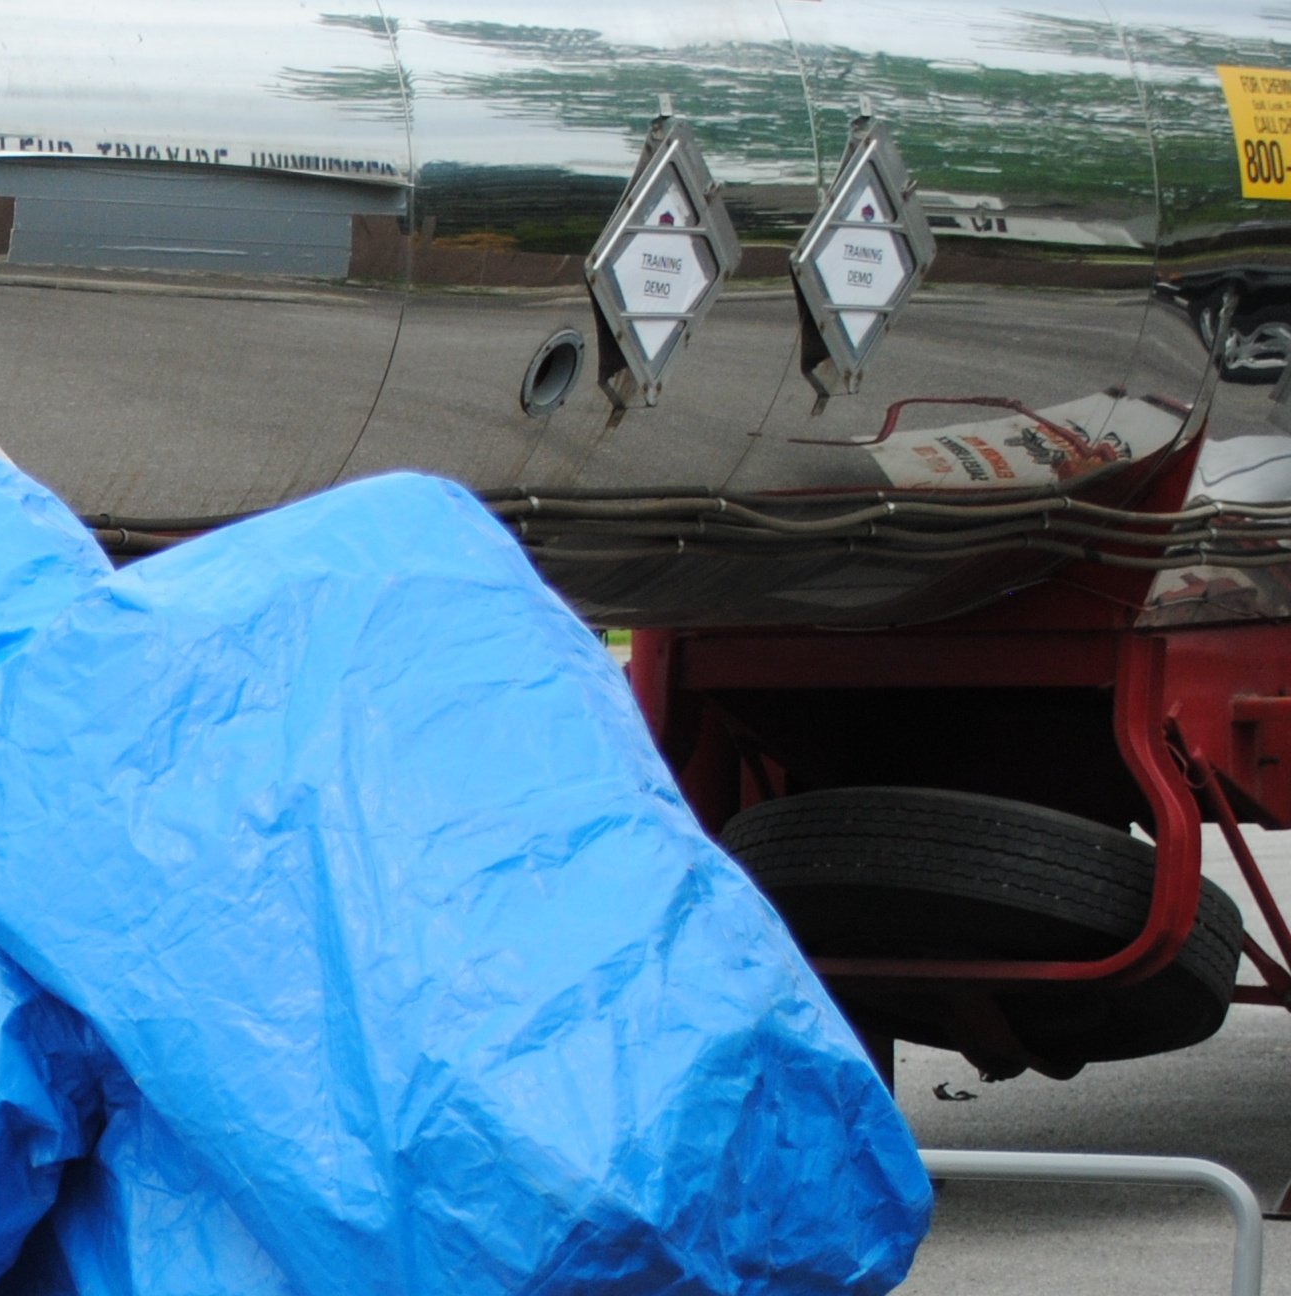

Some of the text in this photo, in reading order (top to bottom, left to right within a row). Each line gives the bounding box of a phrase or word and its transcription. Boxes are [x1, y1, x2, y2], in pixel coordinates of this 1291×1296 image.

[843, 244, 883, 262] TRAINING
[641, 253, 682, 272] TRAINING
[847, 270, 873, 286] DEMO
[644, 280, 671, 296] DEMO
